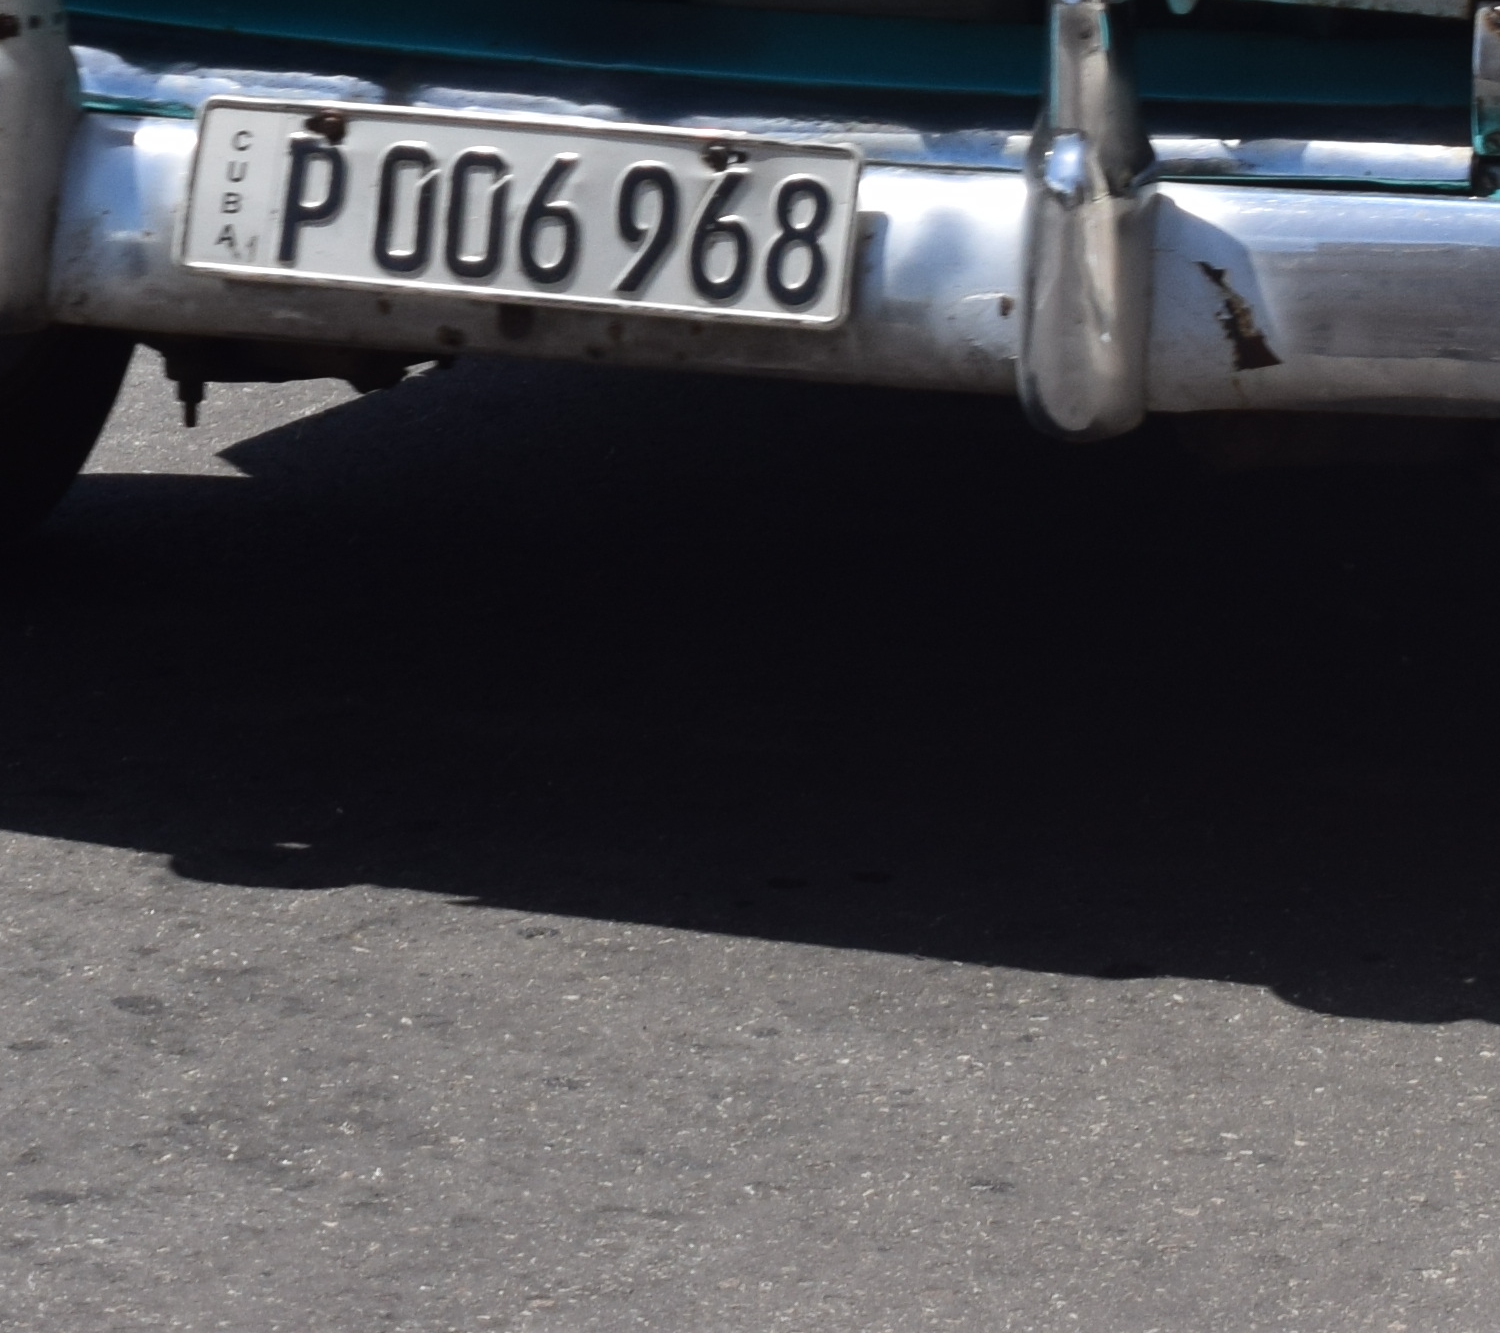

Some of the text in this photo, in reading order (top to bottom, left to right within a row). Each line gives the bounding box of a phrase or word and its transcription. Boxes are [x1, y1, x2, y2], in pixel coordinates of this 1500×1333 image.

[214, 130, 255, 247] CUBA
[278, 135, 832, 307] P 006 968
